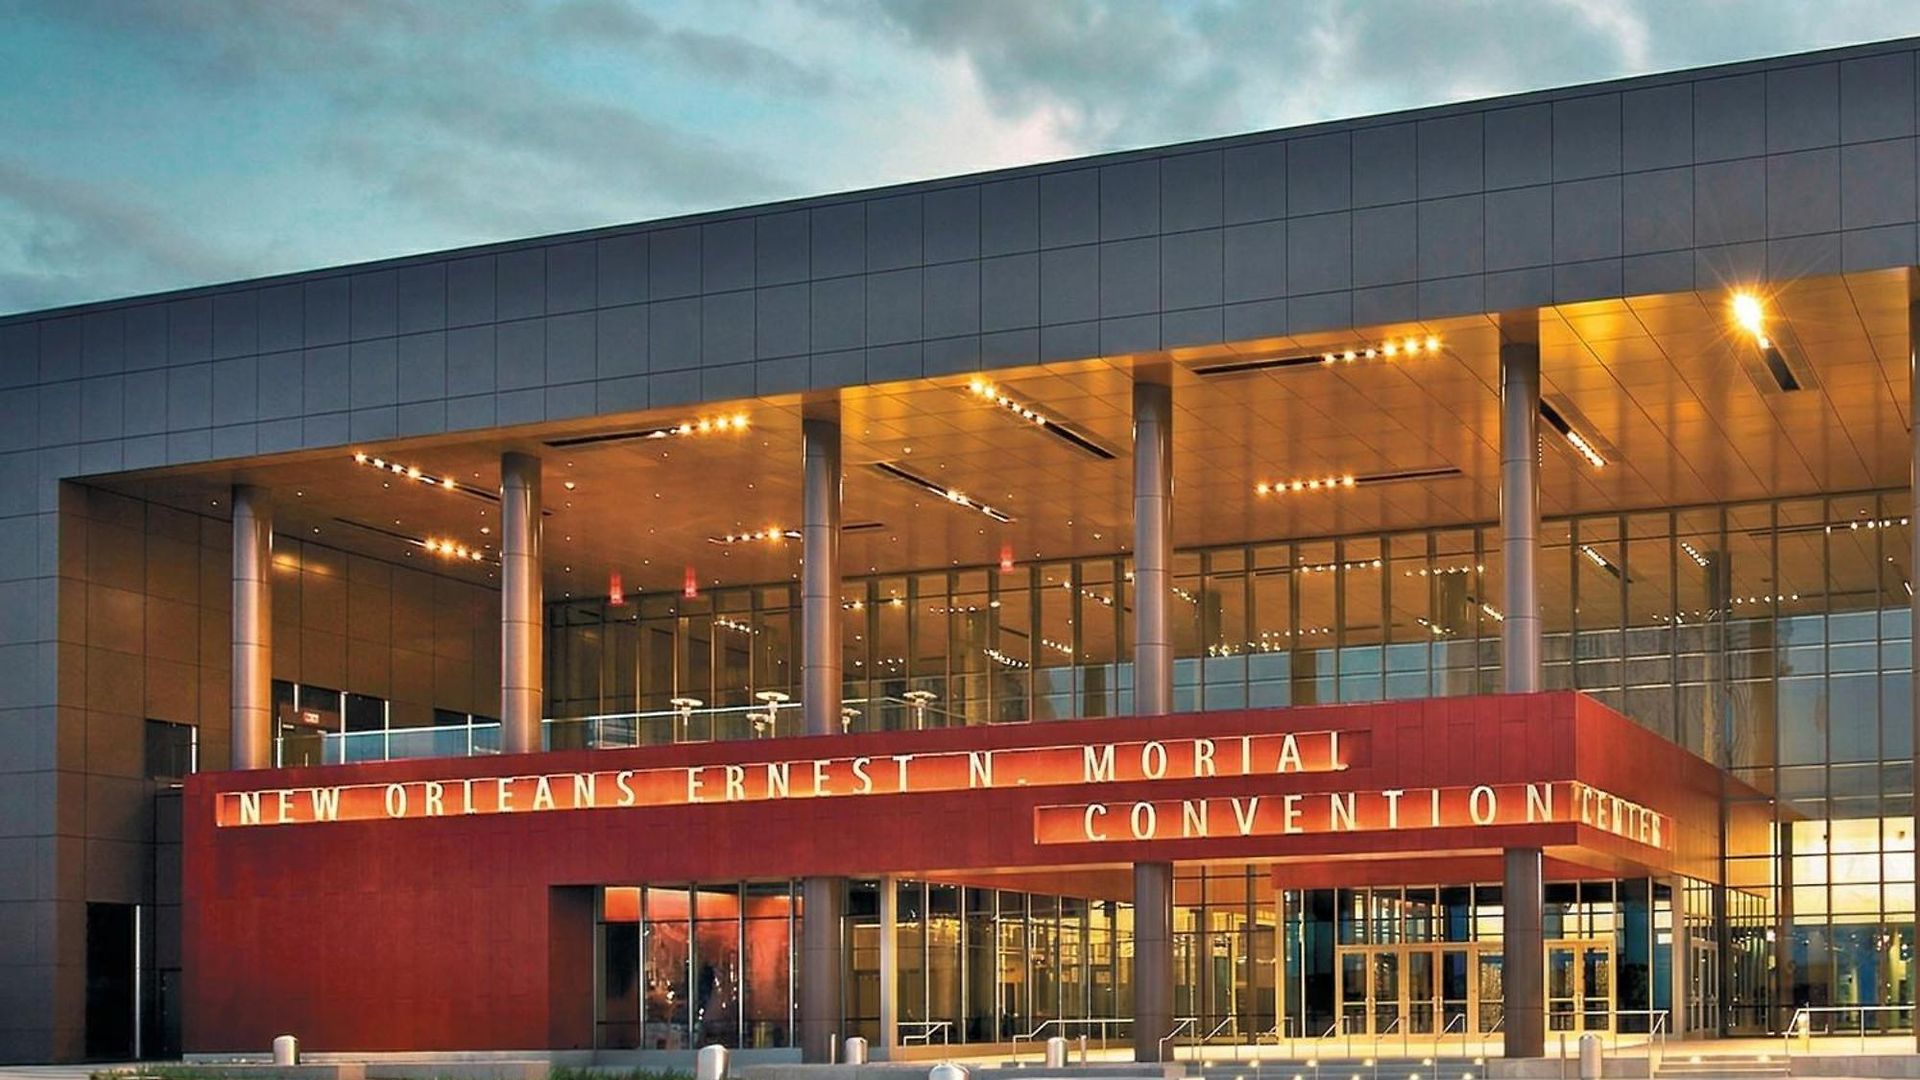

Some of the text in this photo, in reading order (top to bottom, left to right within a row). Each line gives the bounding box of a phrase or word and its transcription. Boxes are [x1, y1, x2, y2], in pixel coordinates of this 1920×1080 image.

[240, 731, 1349, 825] NEW ORLEANS ERNEST N. MORIAL
[1083, 783, 1661, 848] CONVENTION CENTER
